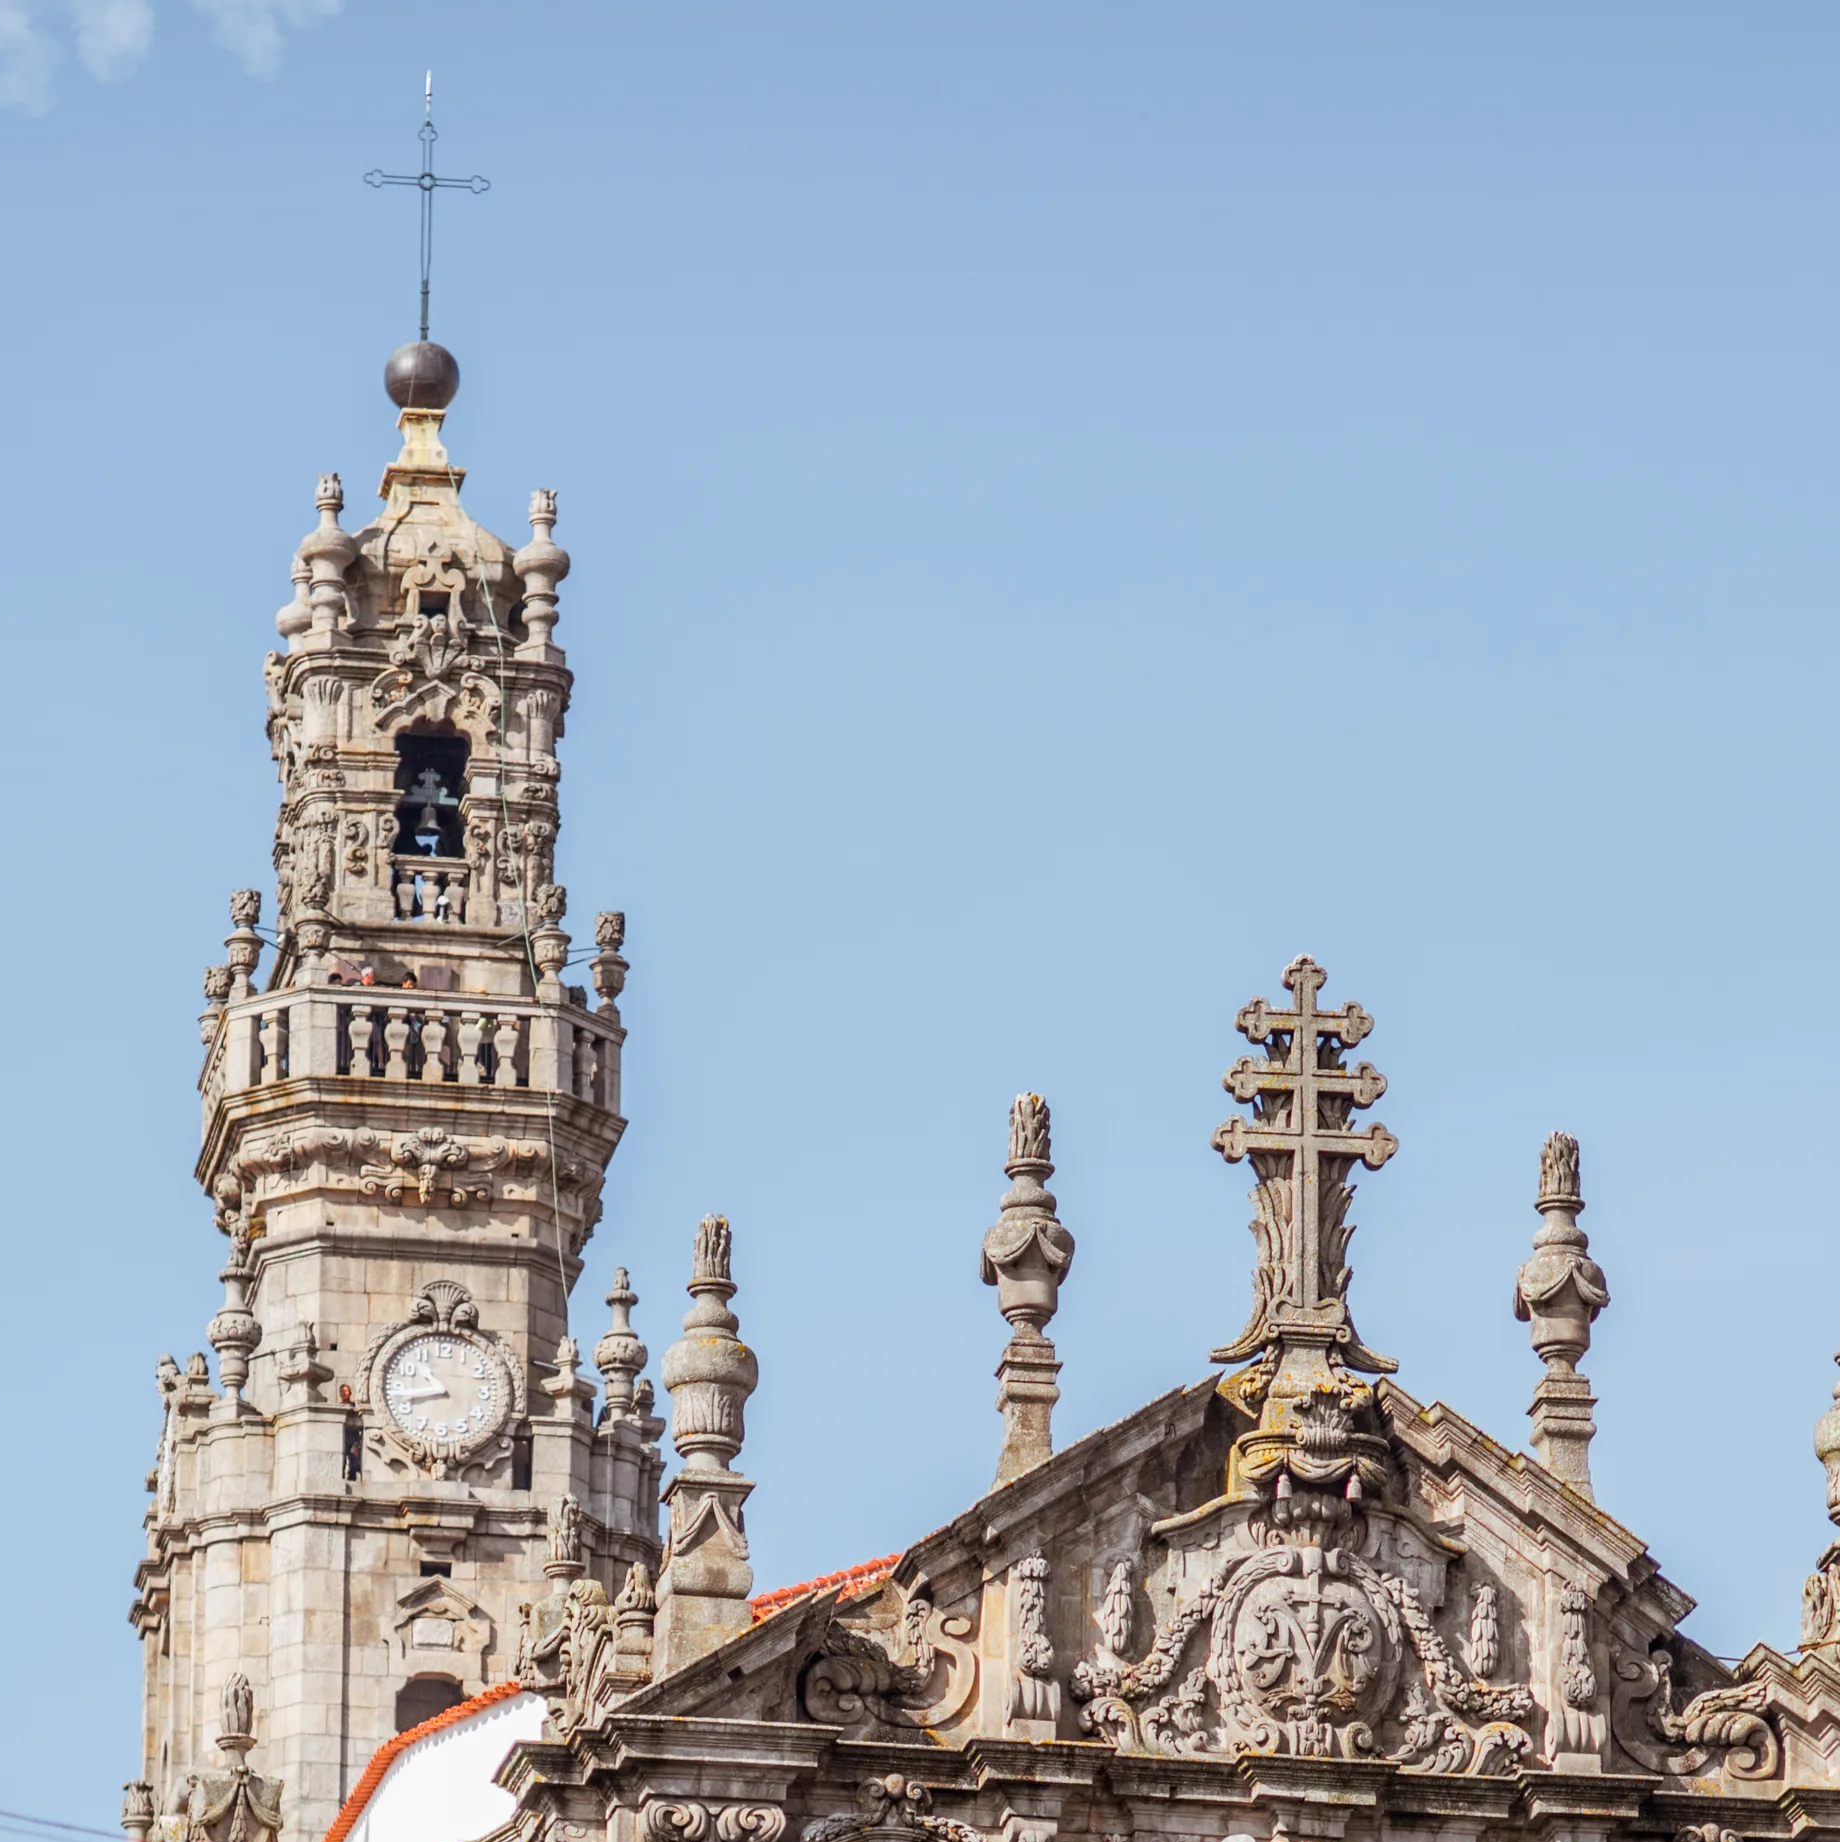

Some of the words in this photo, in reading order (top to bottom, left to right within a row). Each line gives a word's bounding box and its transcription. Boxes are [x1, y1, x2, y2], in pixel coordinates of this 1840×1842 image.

[415, 1349, 429, 1362] 11
[435, 1342, 452, 1358] 12
[460, 1349, 466, 1364] 1
[399, 1362, 416, 1377] 10
[472, 1364, 485, 1379] 2
[477, 1385, 490, 1400] 3
[399, 1399, 412, 1415] 8
[469, 1405, 484, 1421] 4
[416, 1416, 428, 1431] 7
[434, 1422, 448, 1437] 6
[455, 1418, 468, 1433] 5
